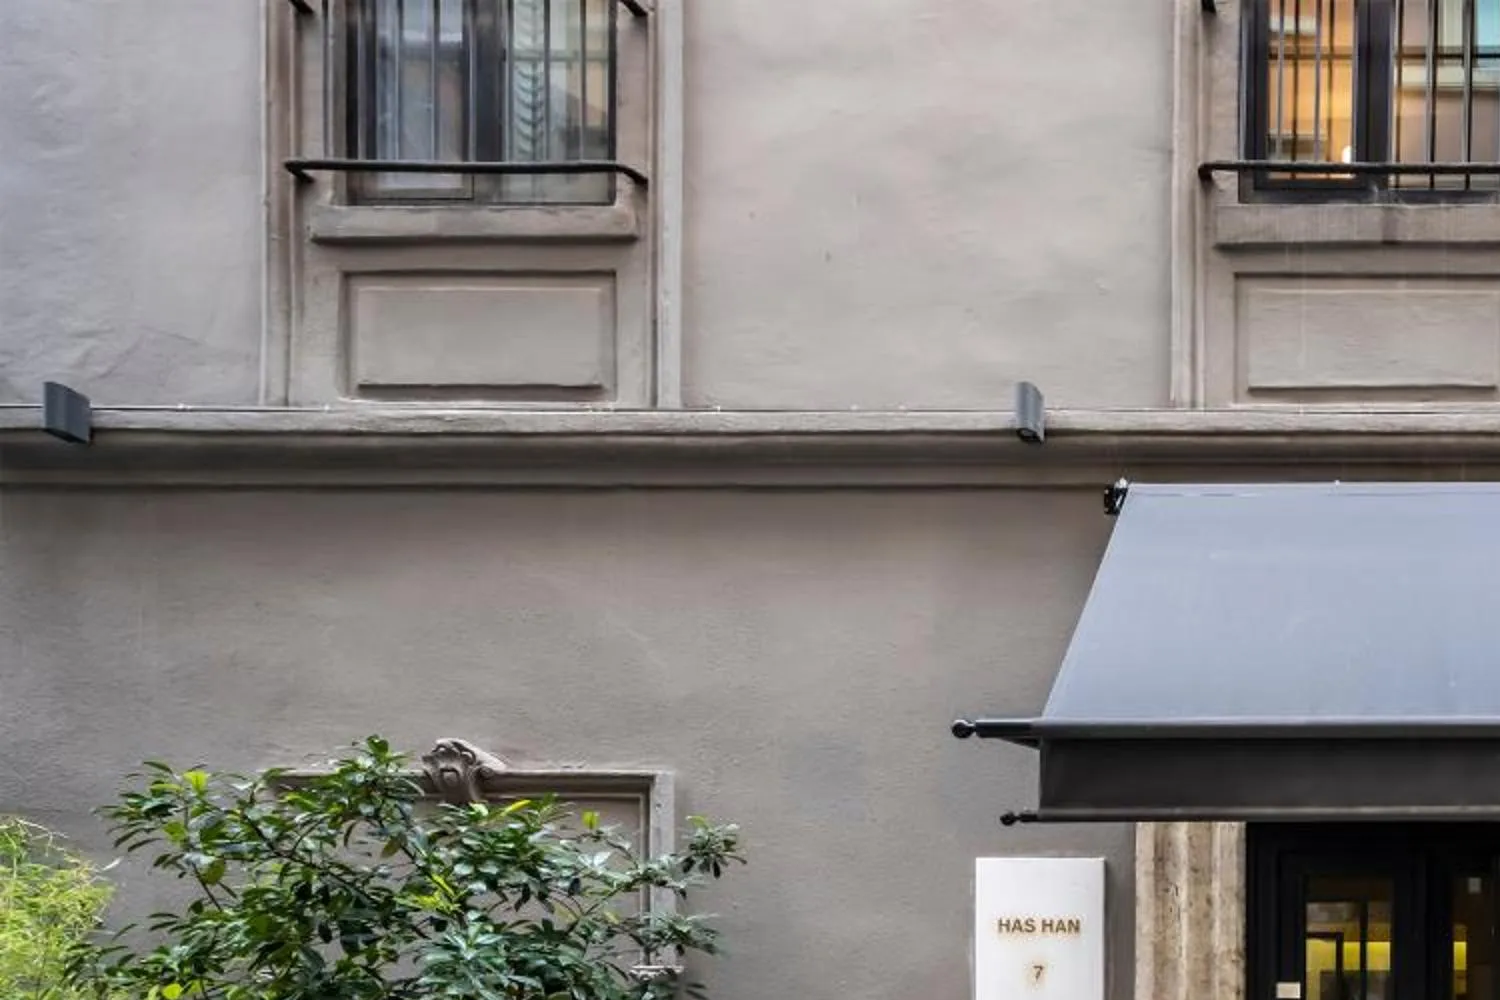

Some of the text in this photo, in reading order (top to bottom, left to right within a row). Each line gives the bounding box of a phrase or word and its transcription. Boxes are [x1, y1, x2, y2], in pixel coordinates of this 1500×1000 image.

[997, 918, 1081, 934] HAS HAN
[1033, 965, 1044, 980] 7
